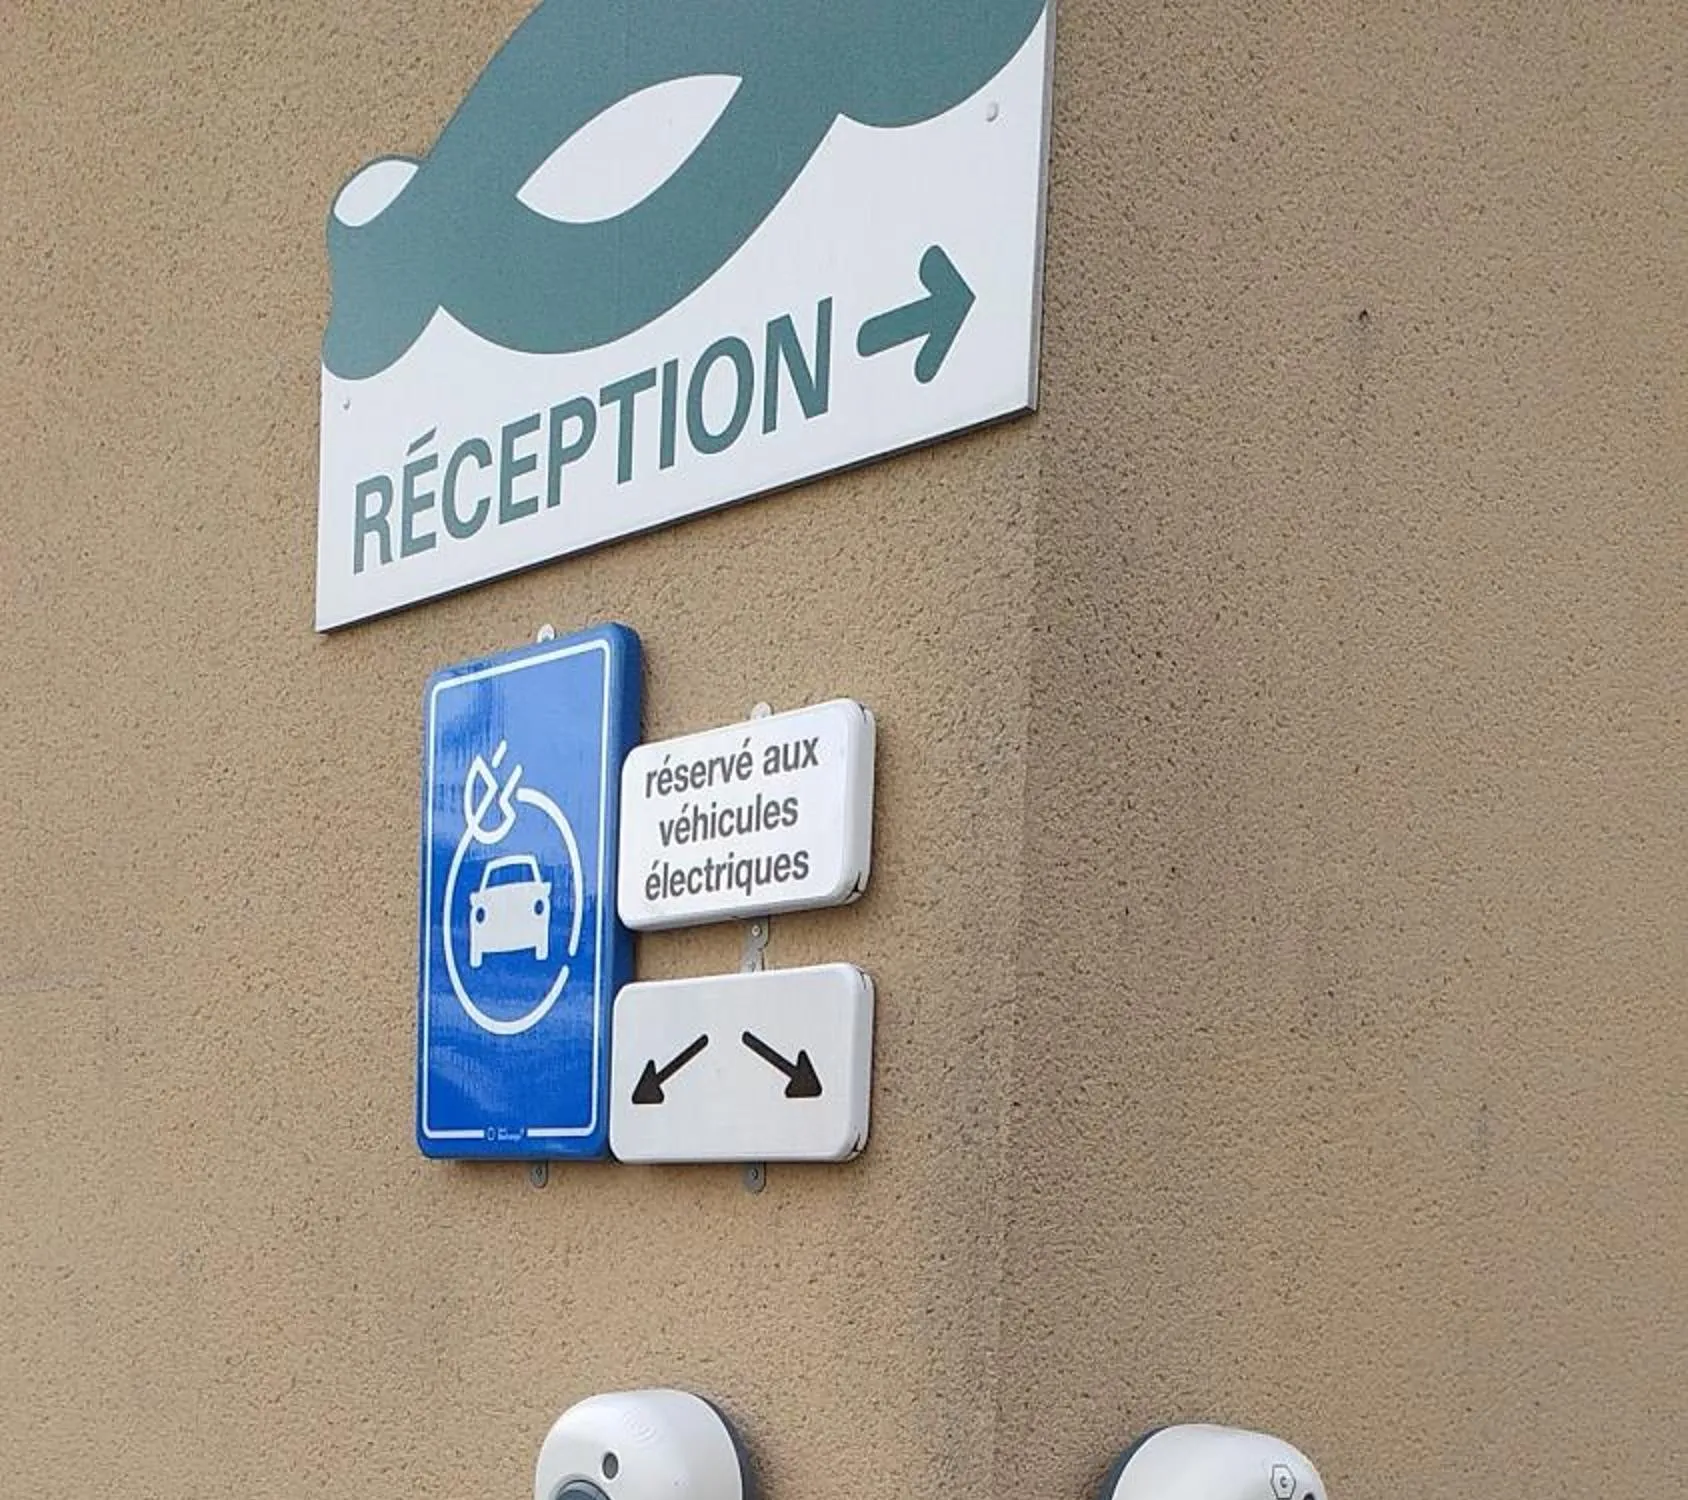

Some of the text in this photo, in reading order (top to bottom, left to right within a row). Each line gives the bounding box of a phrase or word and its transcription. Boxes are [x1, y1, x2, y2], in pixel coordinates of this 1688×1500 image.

[353, 296, 833, 575] RÉCEPTION
[645, 736, 820, 798] réservé aux
[659, 793, 799, 847] véhicules
[645, 850, 810, 901] électriques
